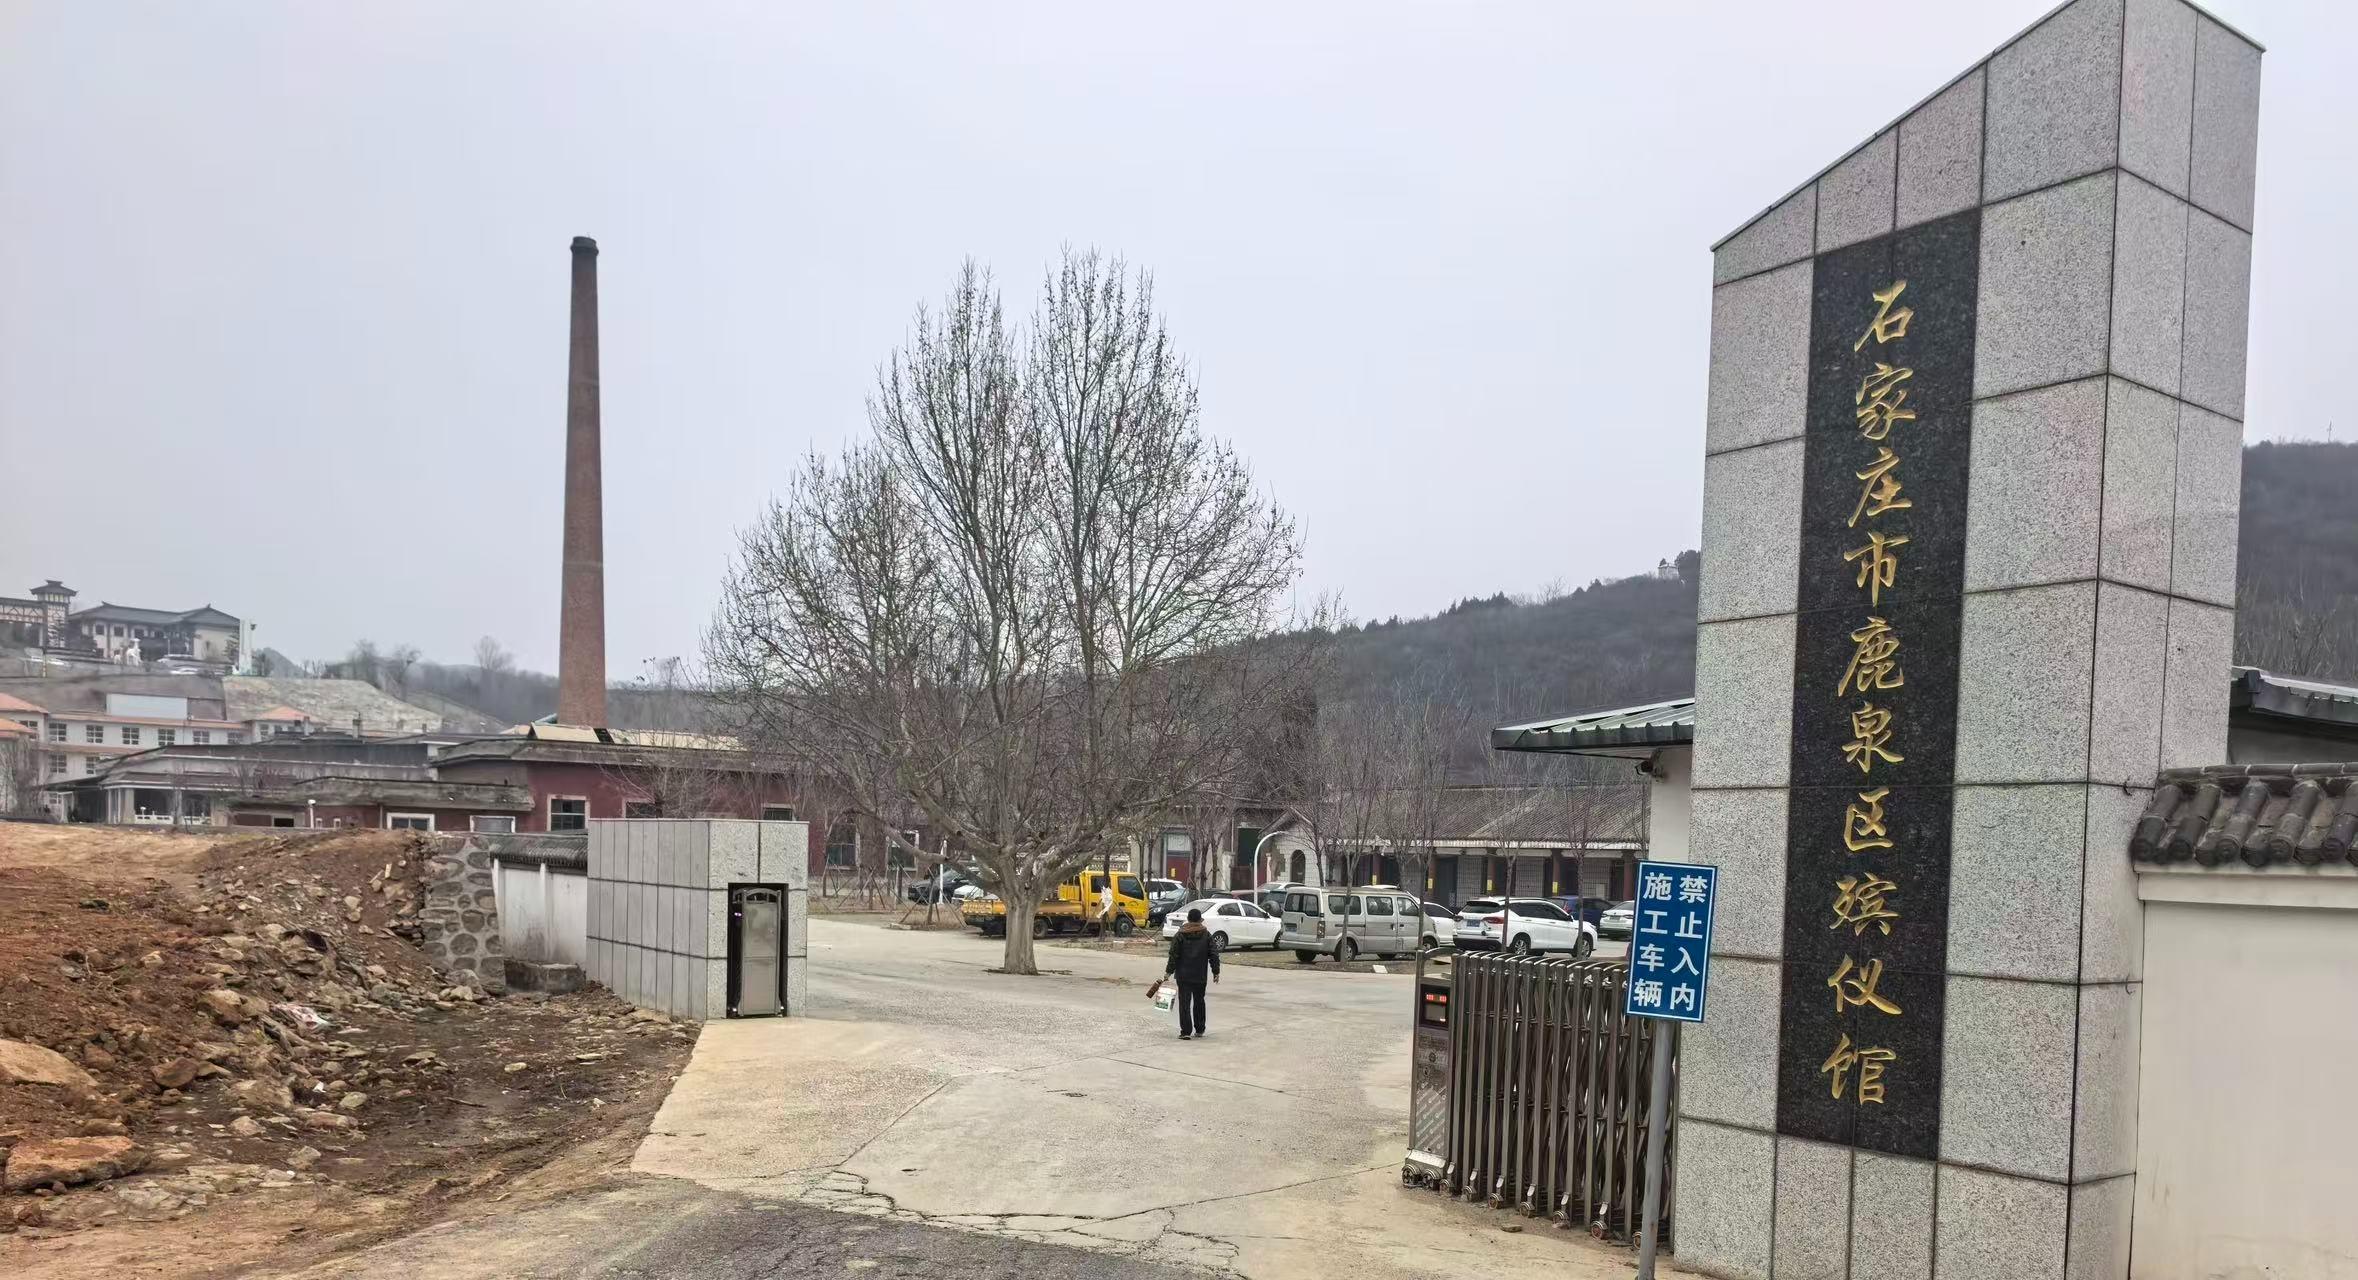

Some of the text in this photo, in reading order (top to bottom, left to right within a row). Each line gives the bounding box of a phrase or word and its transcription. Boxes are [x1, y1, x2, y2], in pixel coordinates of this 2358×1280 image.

[1821, 278, 1916, 1106] 石家庄市鹿泉区殡仪馆
[1633, 871, 1673, 1008] 施工车辆
[1669, 874, 1709, 1012] 禁止入内
